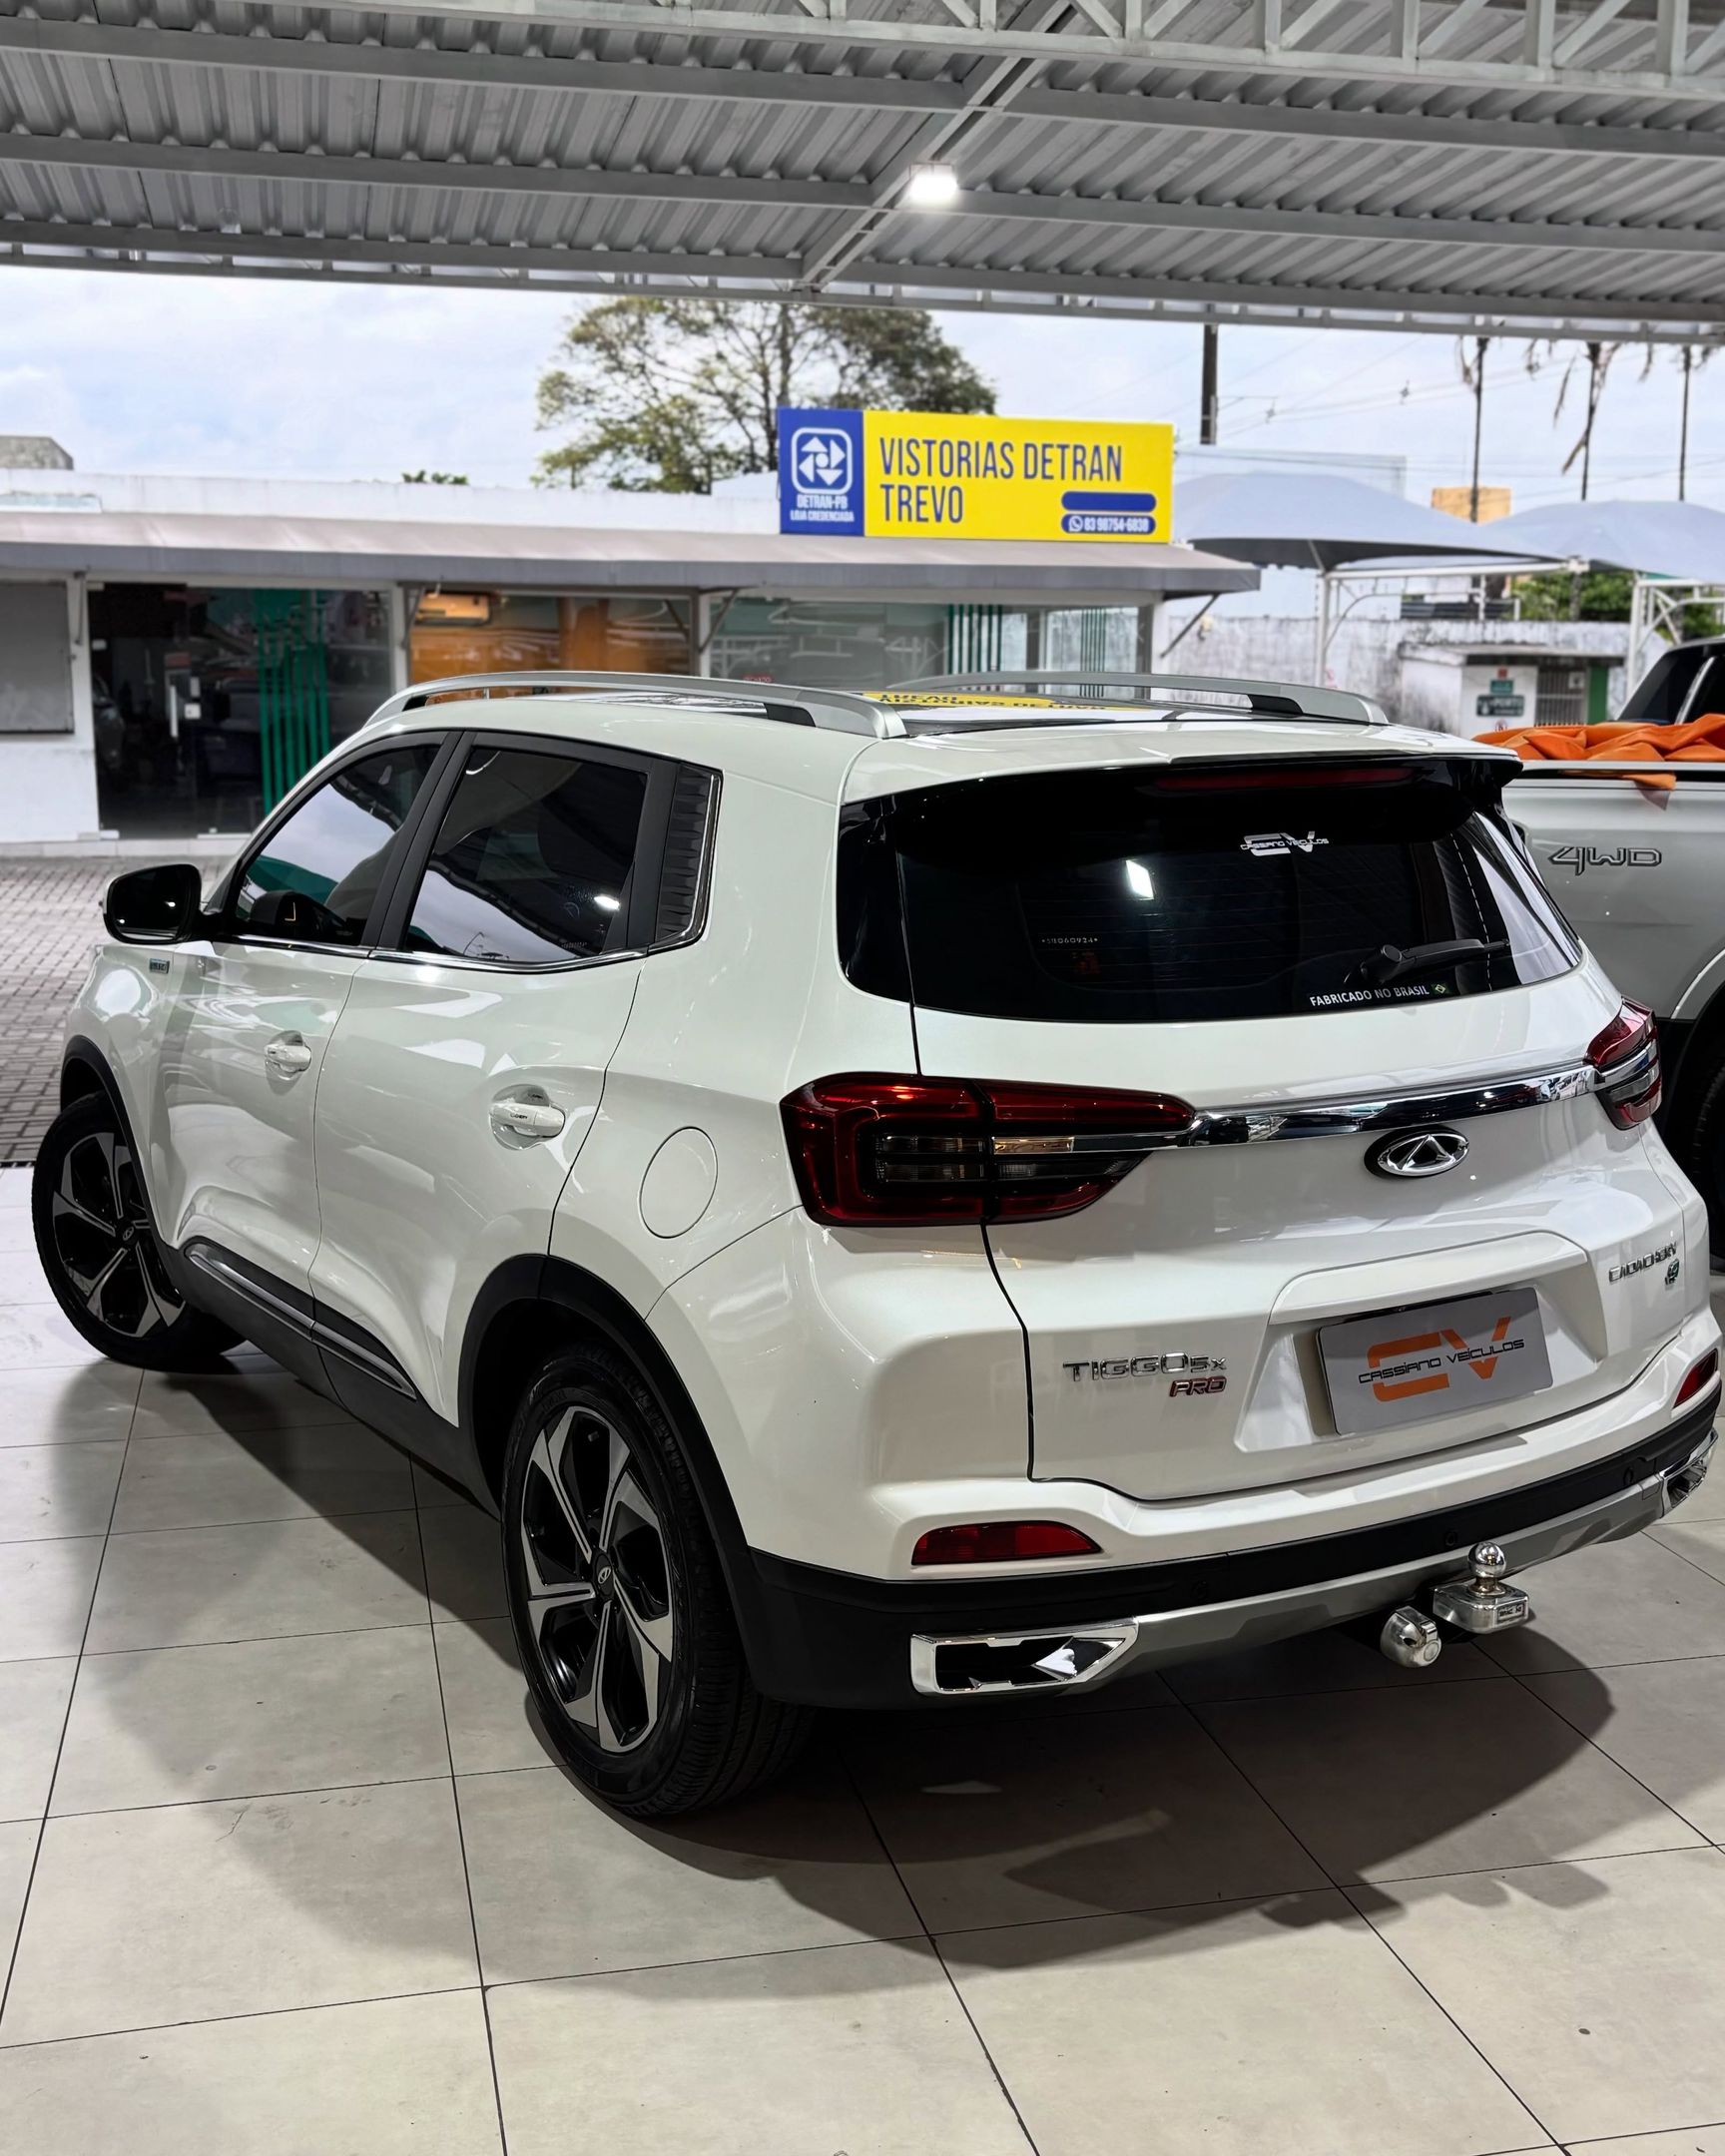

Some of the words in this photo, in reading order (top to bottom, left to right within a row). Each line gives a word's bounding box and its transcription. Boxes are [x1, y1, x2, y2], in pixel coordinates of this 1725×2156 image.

[879, 437, 1014, 479] VISTORIAS
[1023, 442, 1122, 481] DETRAN
[797, 494, 849, 509] DETRAN-PB
[879, 483, 963, 523] TREVO
[1547, 846, 1662, 876] 4WD
[1309, 989, 1373, 1007] FABRICADO
[1374, 988, 1392, 999] NO
[1393, 984, 1431, 997] BRASIL
[1358, 1357, 1442, 1384] CASSIANO
[1169, 1375, 1228, 1397] PRO
